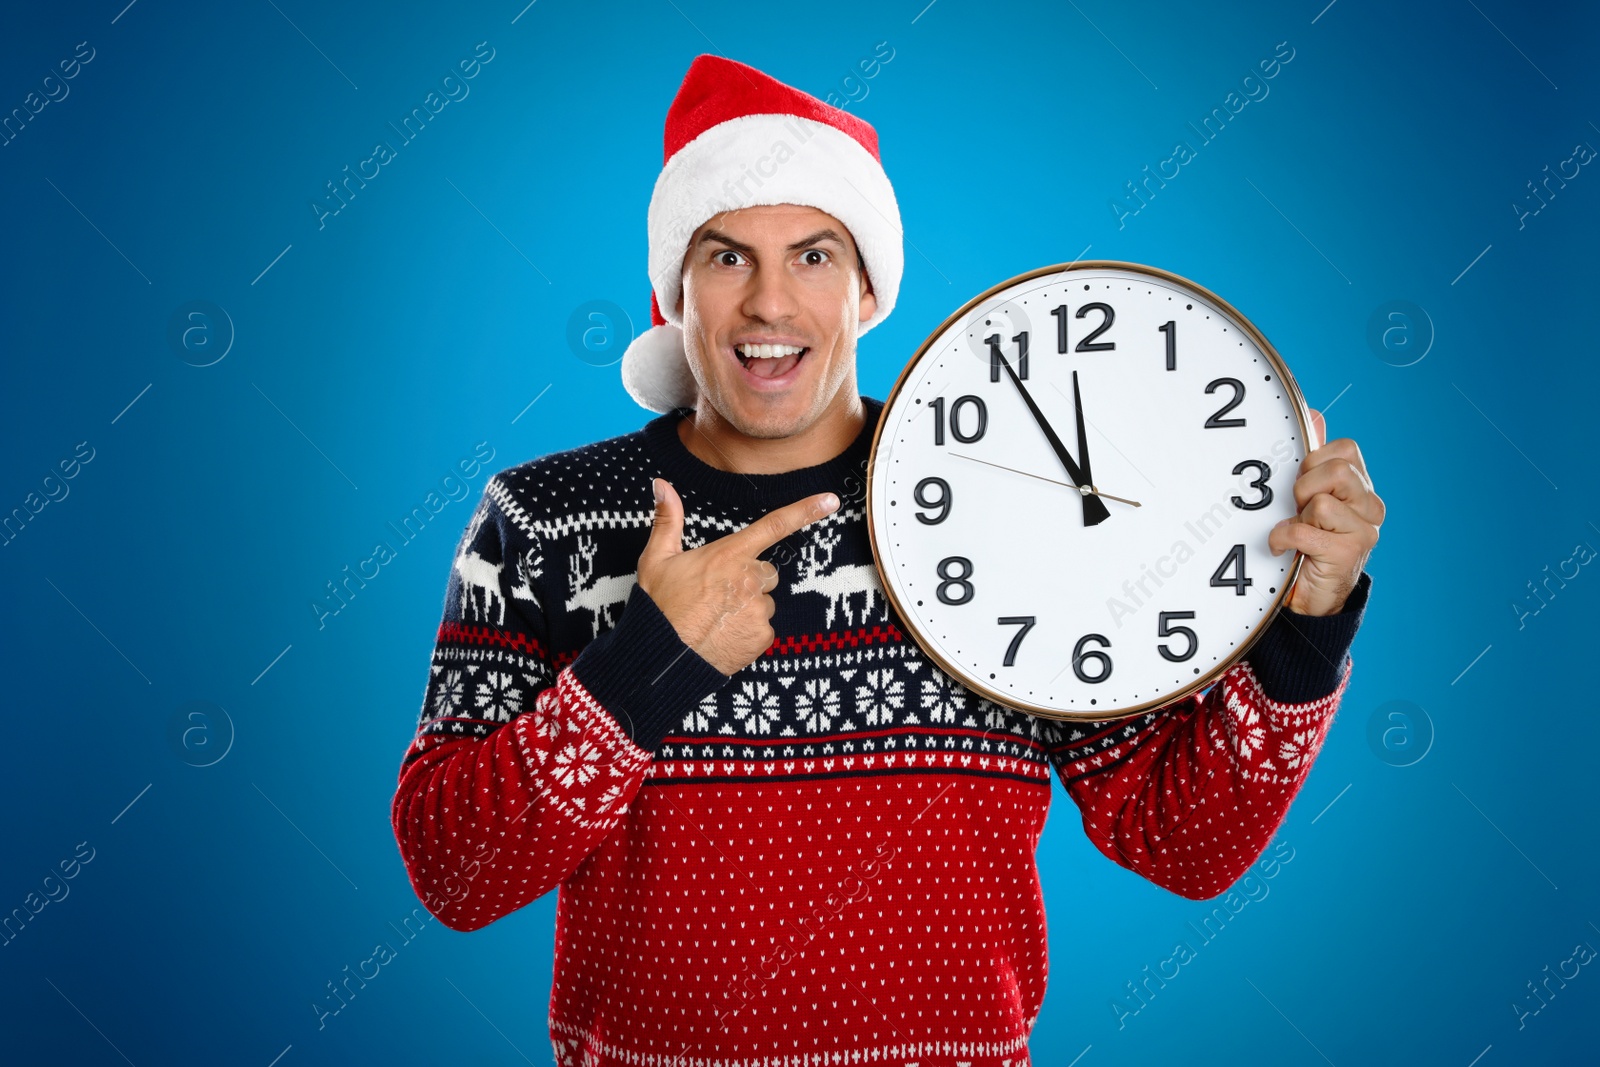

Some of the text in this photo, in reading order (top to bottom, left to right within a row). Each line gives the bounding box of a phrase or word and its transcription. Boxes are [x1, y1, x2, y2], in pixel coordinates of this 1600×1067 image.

[1050, 302, 1116, 354] 12
[1158, 321, 1177, 371] 1
[984, 331, 1029, 383] 11
[928, 394, 989, 446] 10
[1204, 377, 1247, 429] 2
[913, 477, 953, 526] 9
[1231, 460, 1274, 511] 3
[936, 556, 975, 607] 8
[1209, 544, 1253, 596] 4
[997, 616, 1037, 667] 7
[1071, 634, 1113, 684] 6
[1157, 611, 1198, 662] 5
